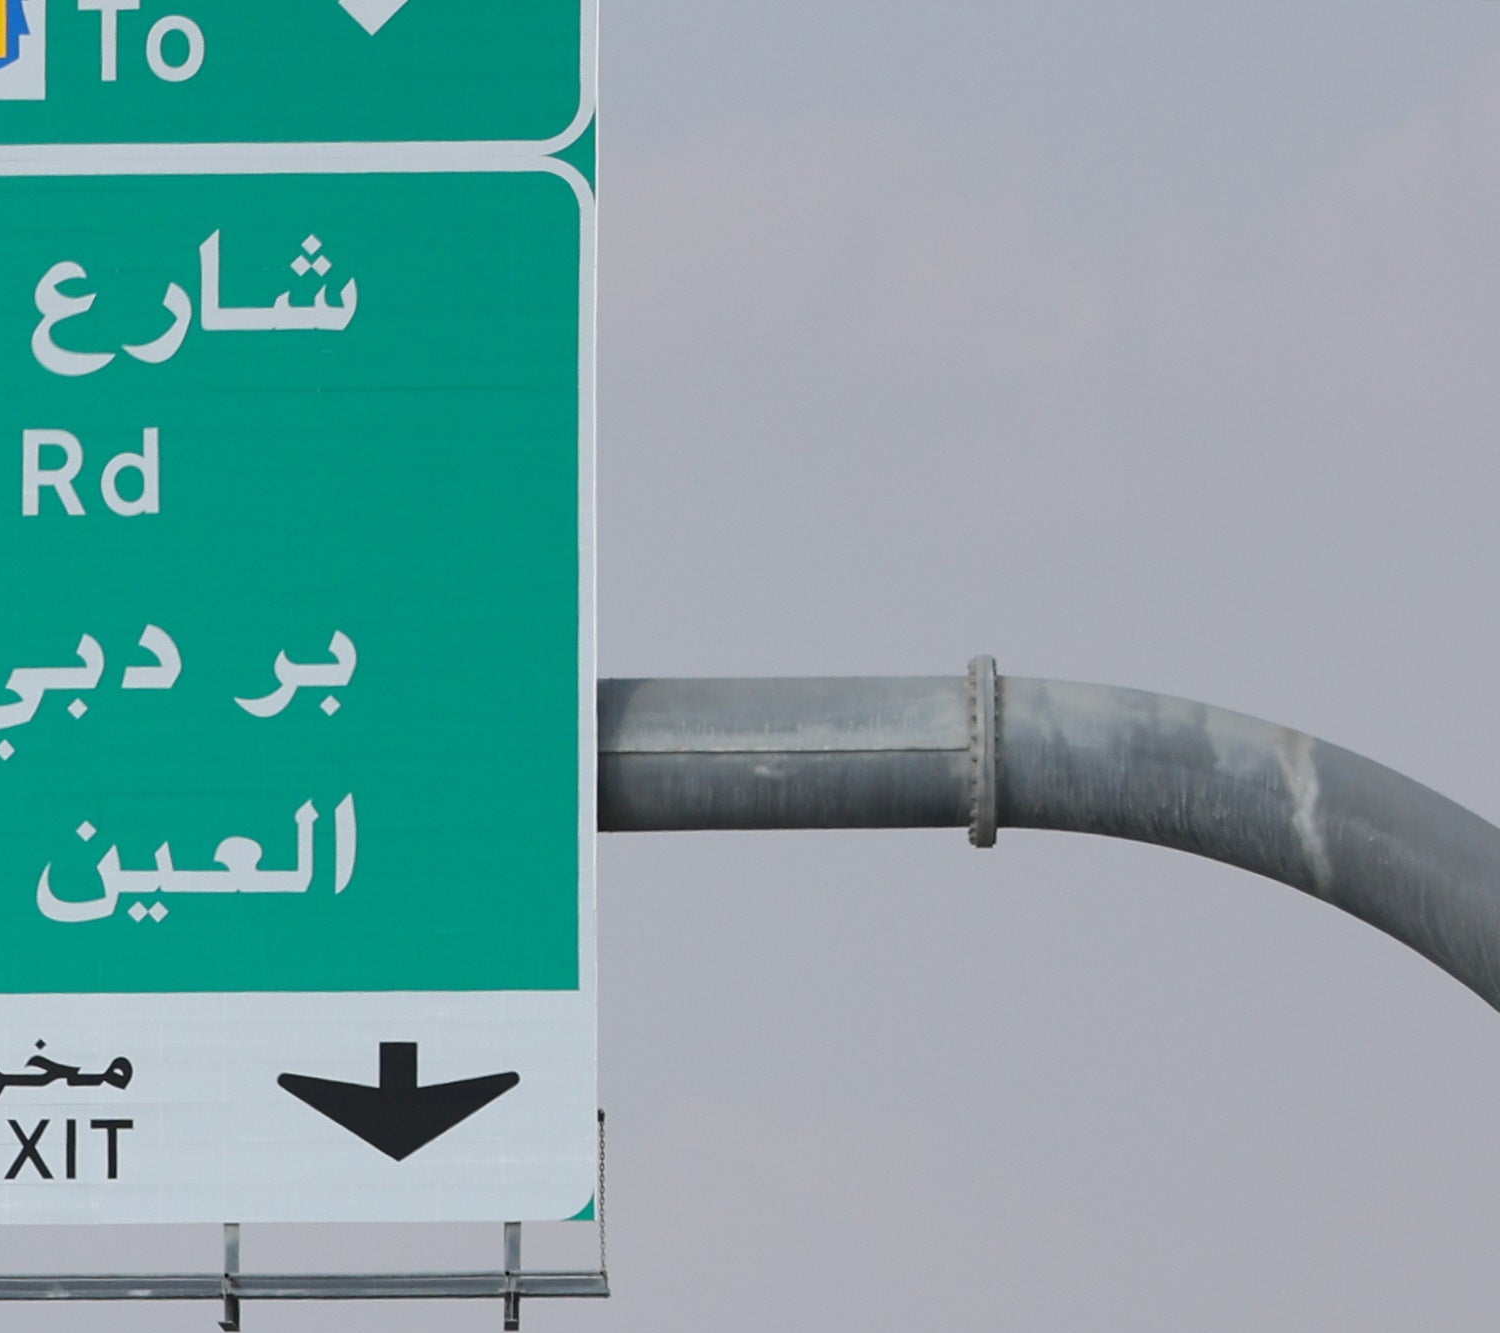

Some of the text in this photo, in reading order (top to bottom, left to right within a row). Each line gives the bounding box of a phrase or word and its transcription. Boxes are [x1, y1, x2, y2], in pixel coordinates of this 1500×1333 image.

[78, 0, 204, 81] To
[32, 230, 357, 376] شارع
[23, 428, 159, 516] Rd
[235, 631, 356, 717] بر
[37, 794, 356, 922] العين
